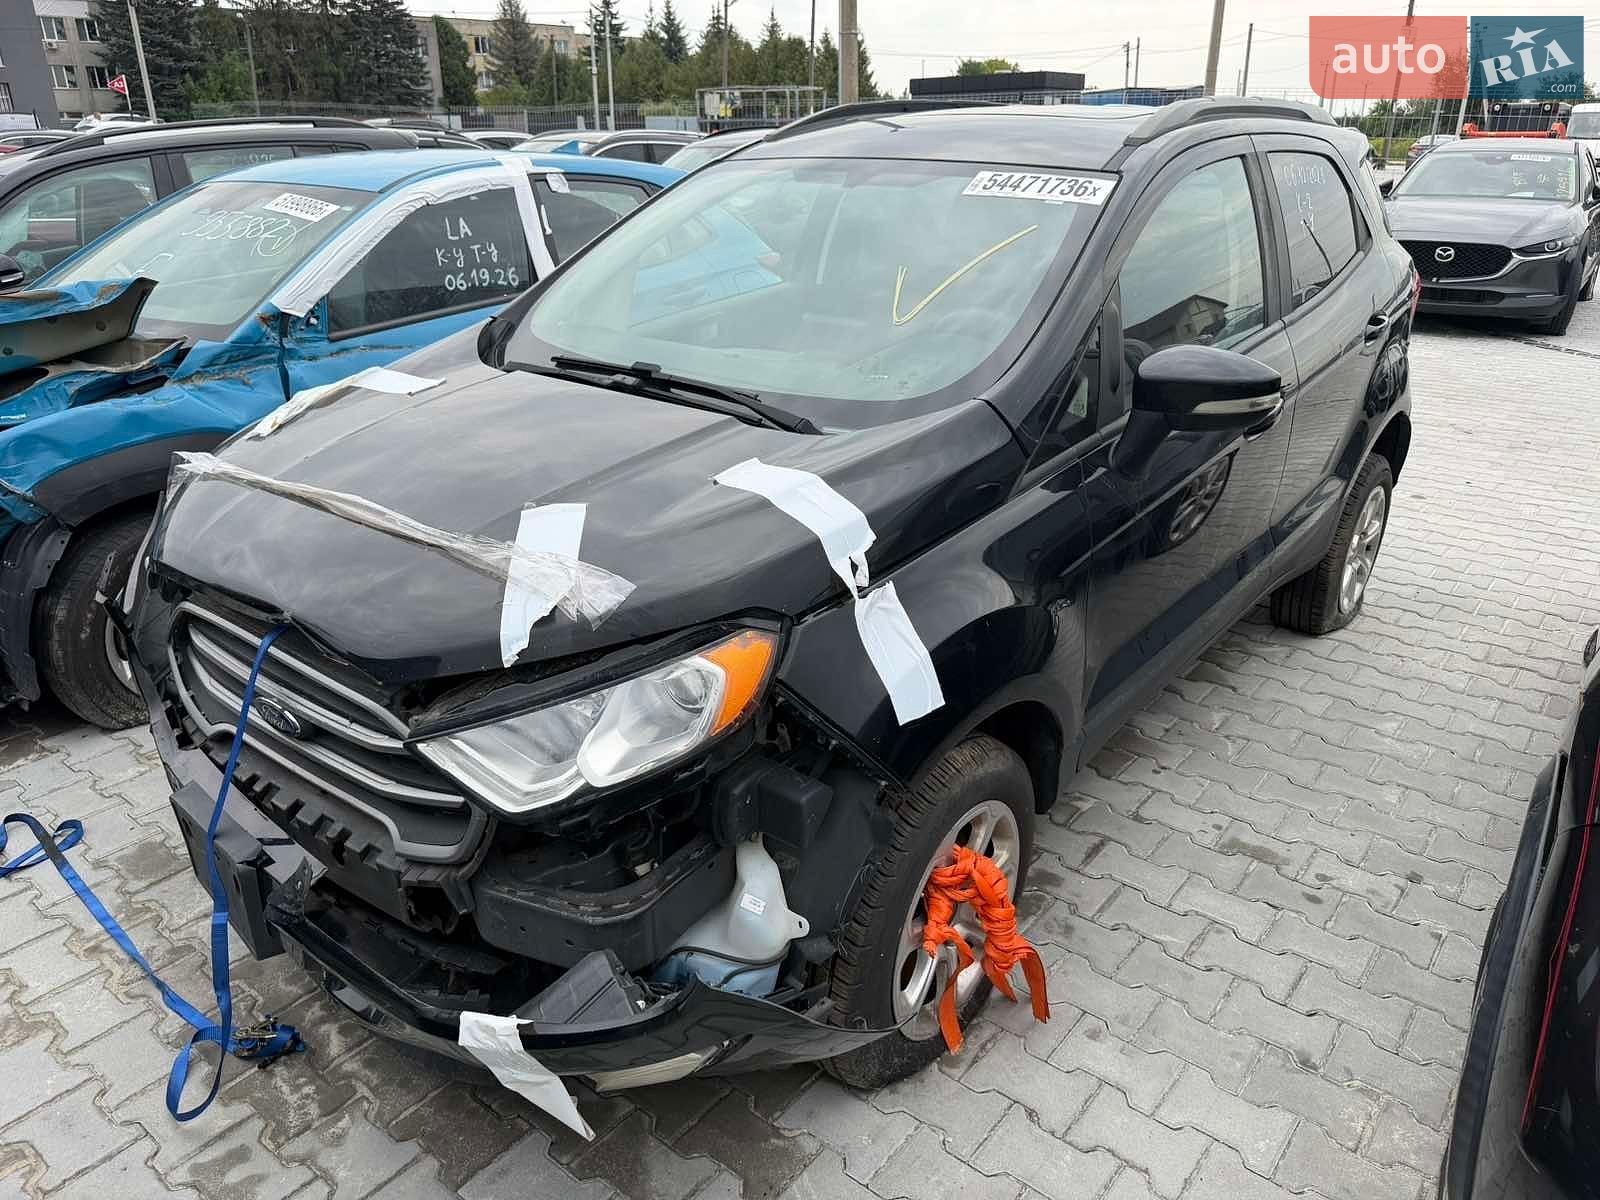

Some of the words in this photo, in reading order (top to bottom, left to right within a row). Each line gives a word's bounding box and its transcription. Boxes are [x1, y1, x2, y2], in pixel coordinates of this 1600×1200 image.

[445, 217, 472, 240] LA
[445, 266, 520, 291] 06.19.26
[261, 704, 289, 730] Ford
